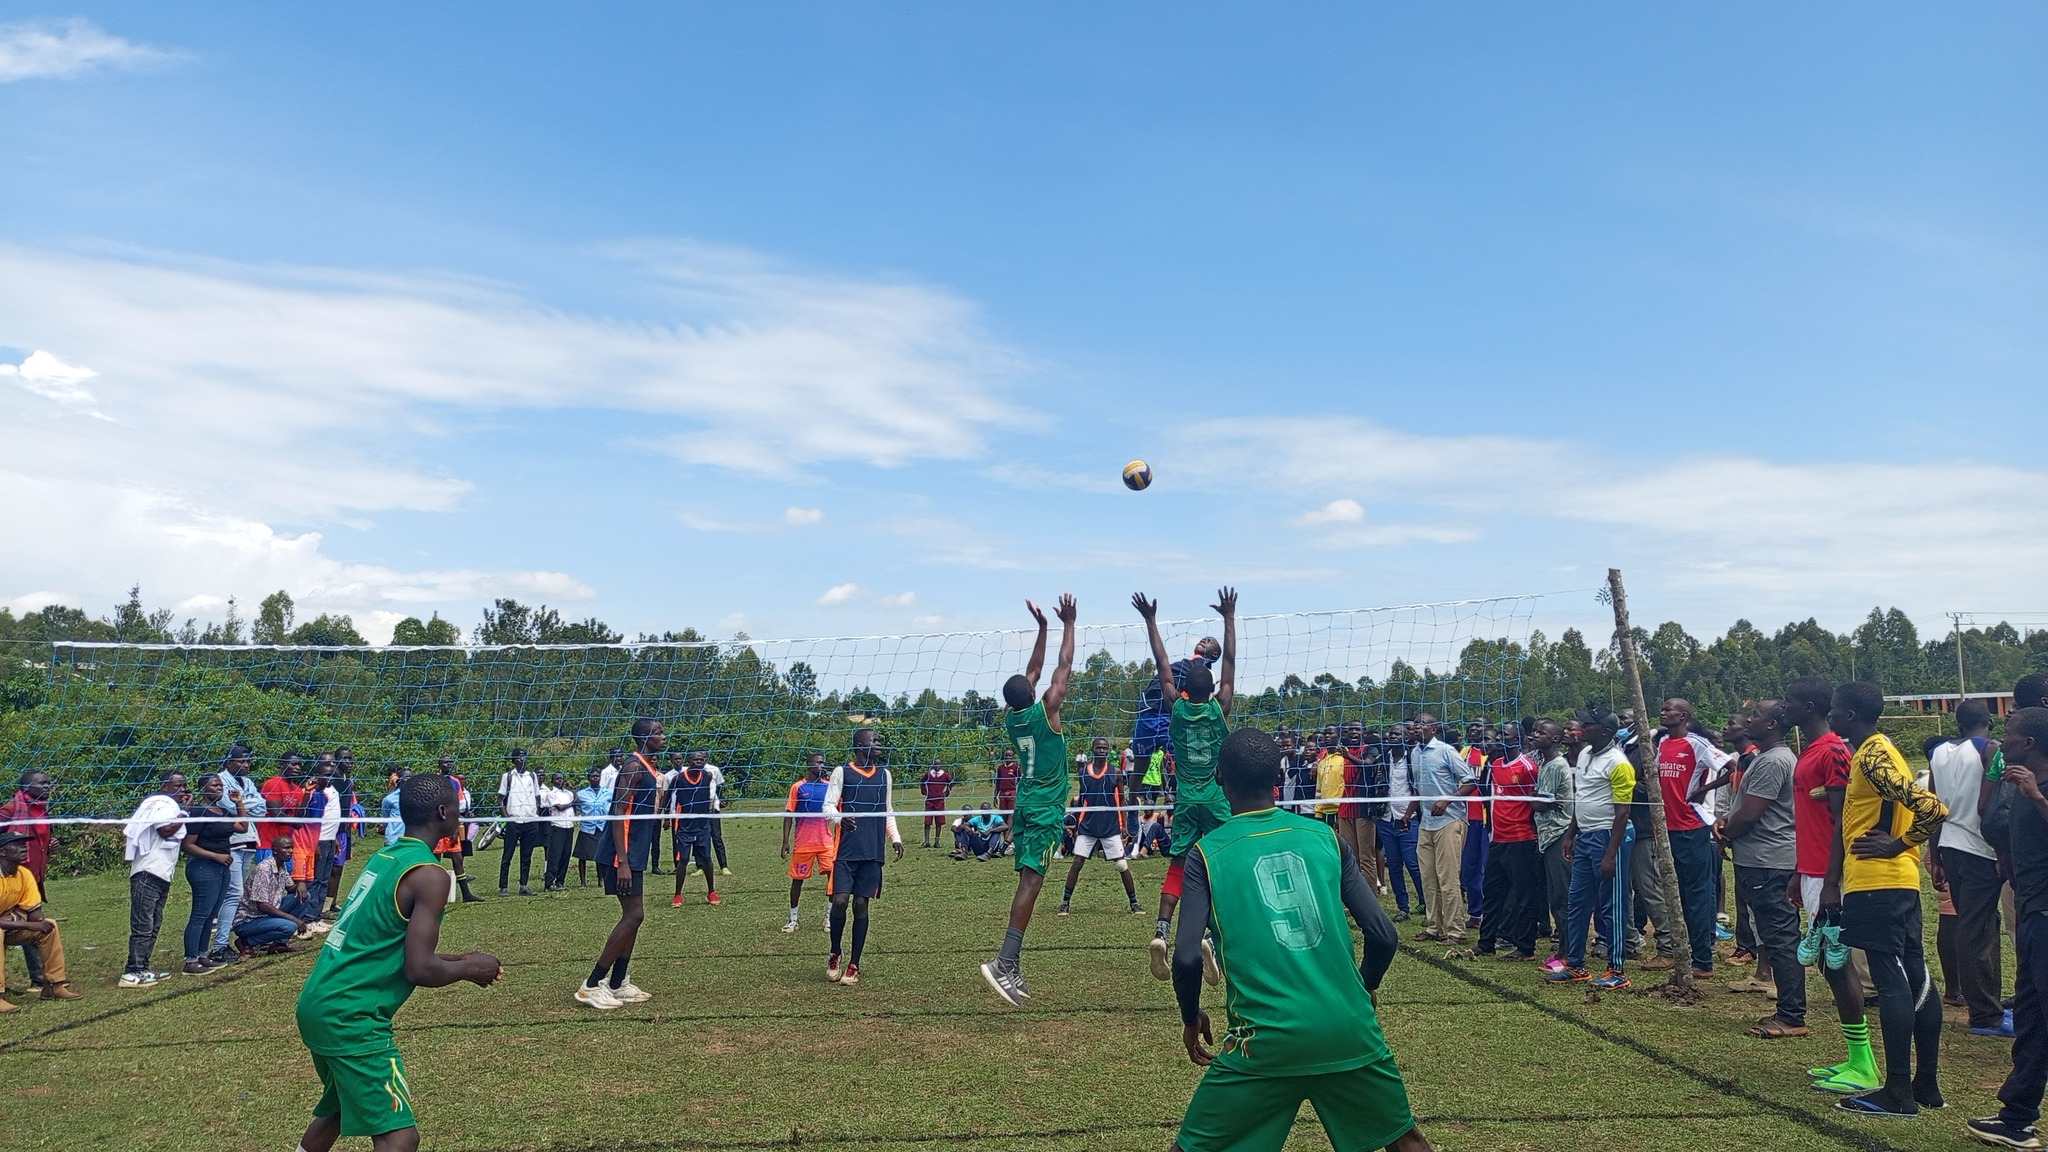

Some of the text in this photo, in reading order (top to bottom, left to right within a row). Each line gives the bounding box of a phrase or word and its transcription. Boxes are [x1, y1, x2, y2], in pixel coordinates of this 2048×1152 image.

[1016, 735, 1036, 778] 7
[1186, 724, 1212, 765] 6
[1660, 761, 1686, 771] mirates
[325, 870, 378, 951] 2
[1253, 850, 1325, 951] 9
